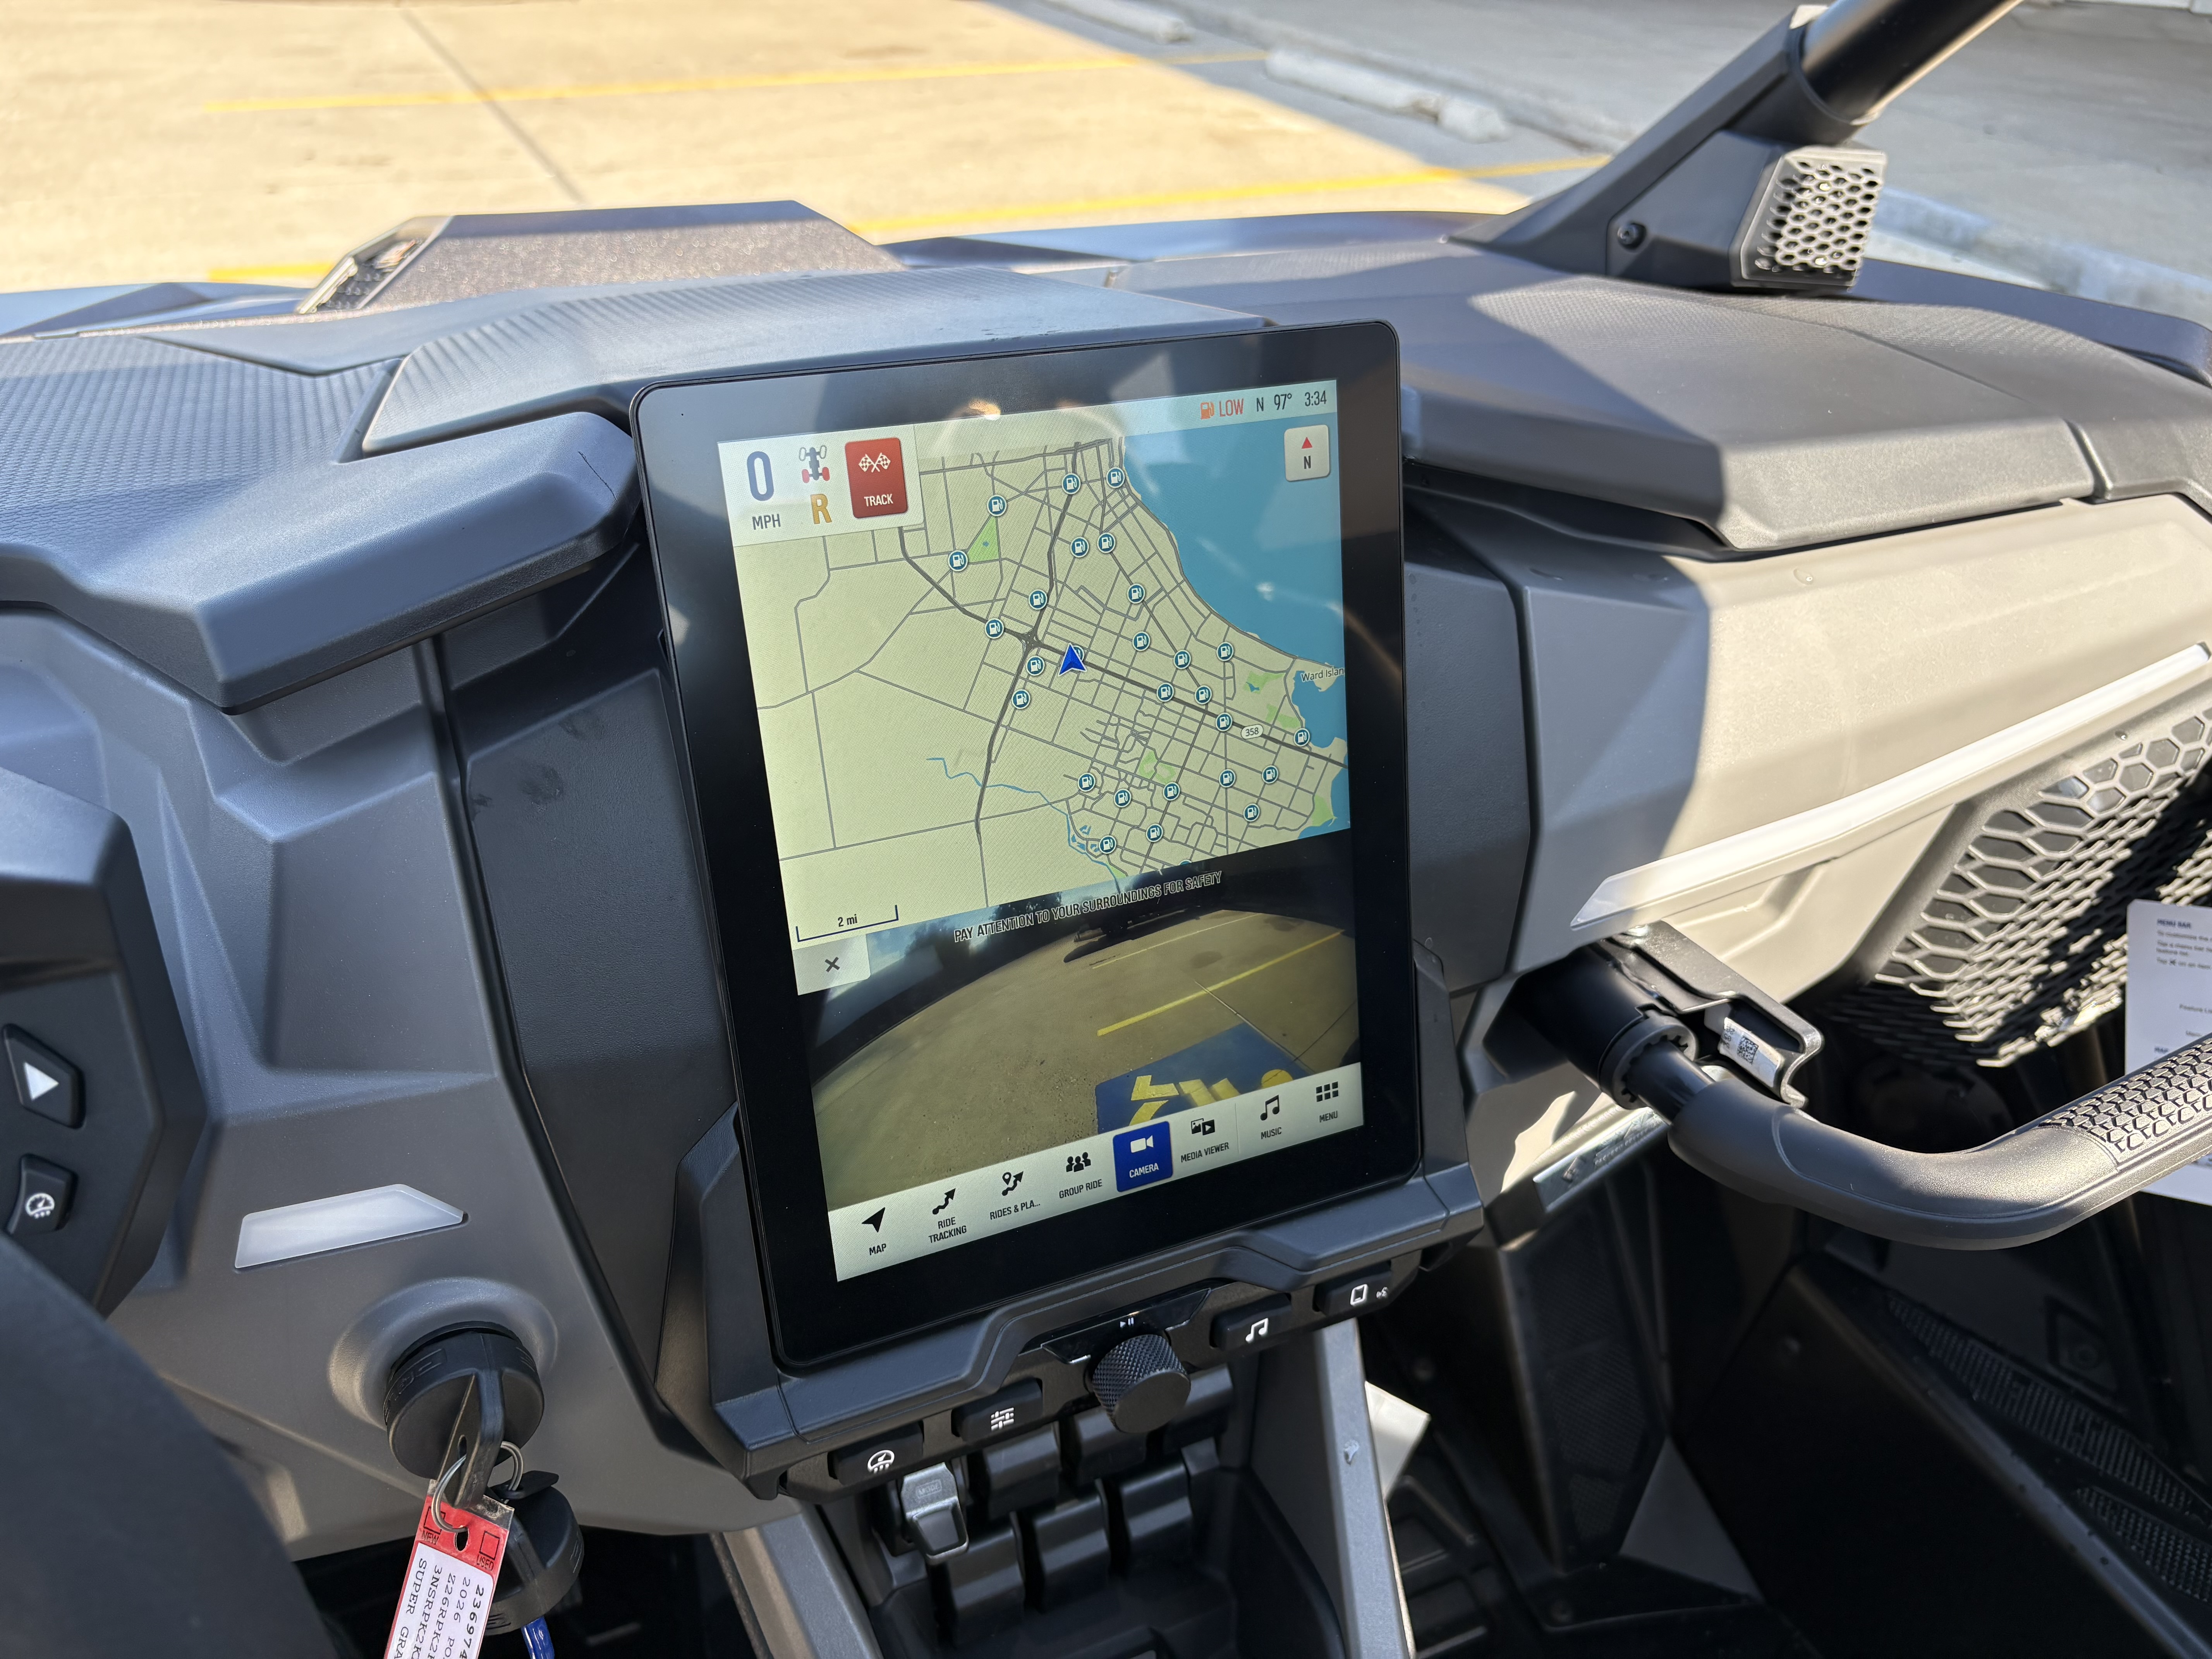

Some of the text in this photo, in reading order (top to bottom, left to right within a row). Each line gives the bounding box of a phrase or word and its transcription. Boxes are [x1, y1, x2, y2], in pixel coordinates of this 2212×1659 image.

[1219, 390, 1327, 417] LOW N 97° 3:34
[1304, 455, 1312, 469] N
[747, 451, 775, 501] 0
[864, 493, 893, 507] TRACK
[811, 493, 832, 524] R
[752, 514, 781, 530] MPH
[1301, 670, 1323, 682] Ward
[1245, 728, 1259, 737] 358
[955, 871, 1223, 942] PAY ATTENTION TO YOUR SURROUNDINGS FOR SAFETY
[838, 914, 858, 927] 2 mi
[1319, 1110, 1338, 1123] MENU
[1261, 1127, 1282, 1140] MUSIC
[1181, 1142, 1230, 1163] MEDIA VIEWER
[1129, 1163, 1159, 1178] CAMERA
[1059, 1179, 1103, 1199] GROUP RIDE
[989, 1207, 1012, 1220] RIDES
[1013, 1204, 1019, 1213] &
[938, 1217, 956, 1230] RIDE
[928, 1225, 967, 1243] TRACKING
[869, 1243, 886, 1255] MAP
[421, 1530, 439, 1545] NEW
[477, 1554, 494, 1571] USED
[406, 1558, 427, 1614] SUPER
[443, 1577, 471, 1659] 2026 PO
[459, 1584, 484, 1659] 236974
